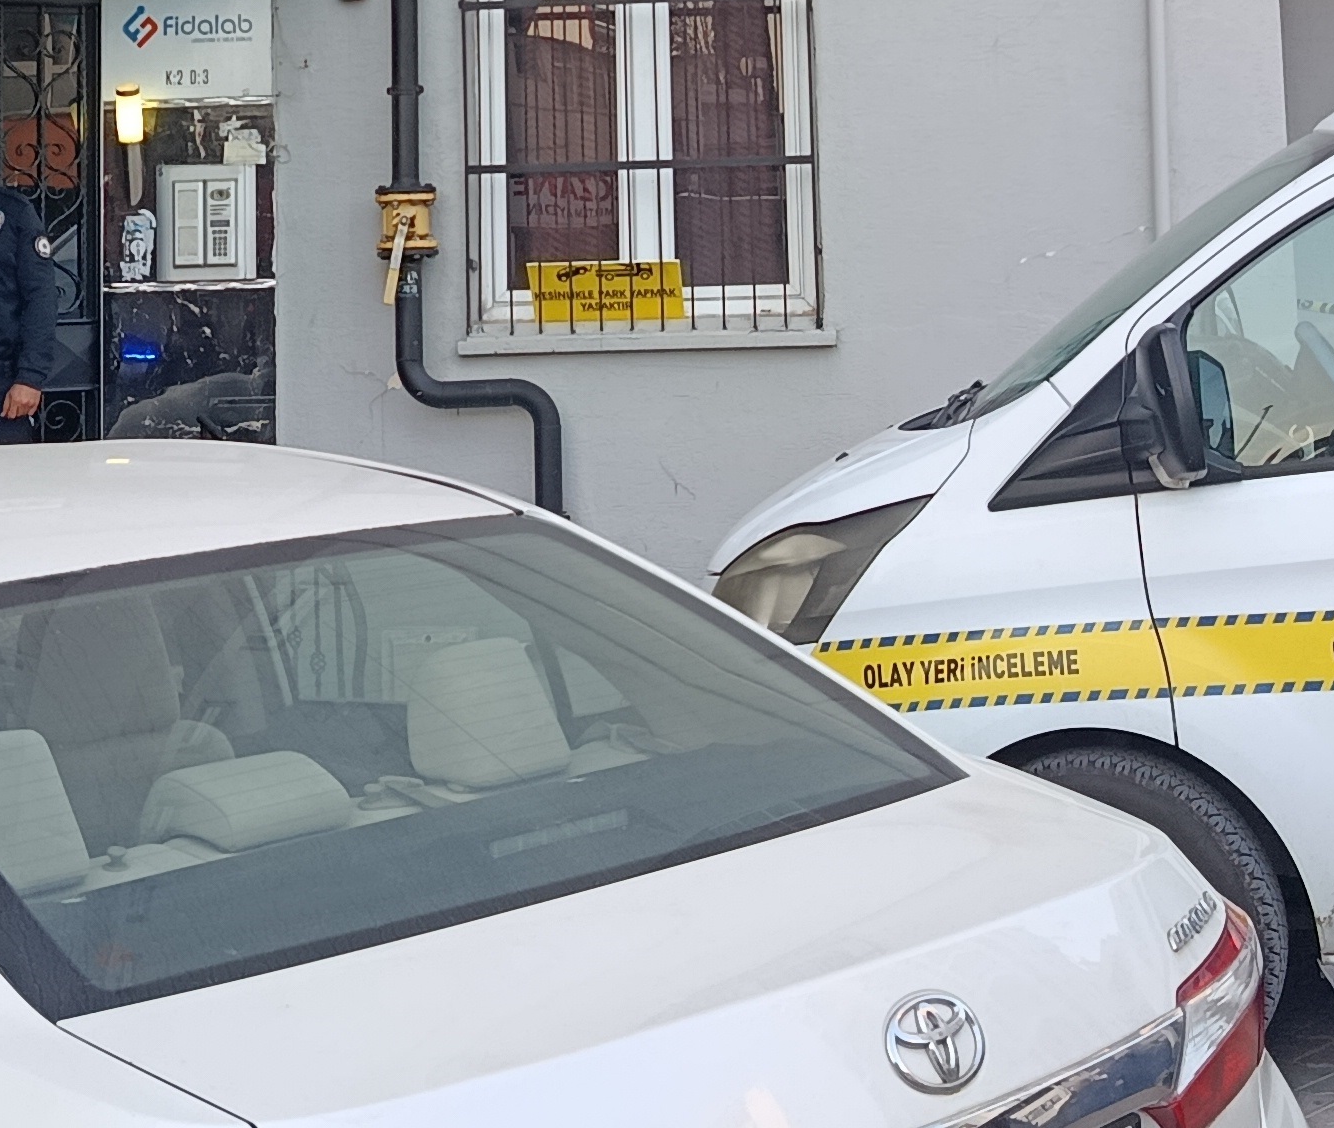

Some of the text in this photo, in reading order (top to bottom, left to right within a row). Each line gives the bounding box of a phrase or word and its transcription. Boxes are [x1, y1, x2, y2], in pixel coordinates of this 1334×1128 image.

[163, 13, 253, 37] fidalab
[534, 289, 594, 301] KESİNLKLE
[863, 661, 915, 690] OLAY
